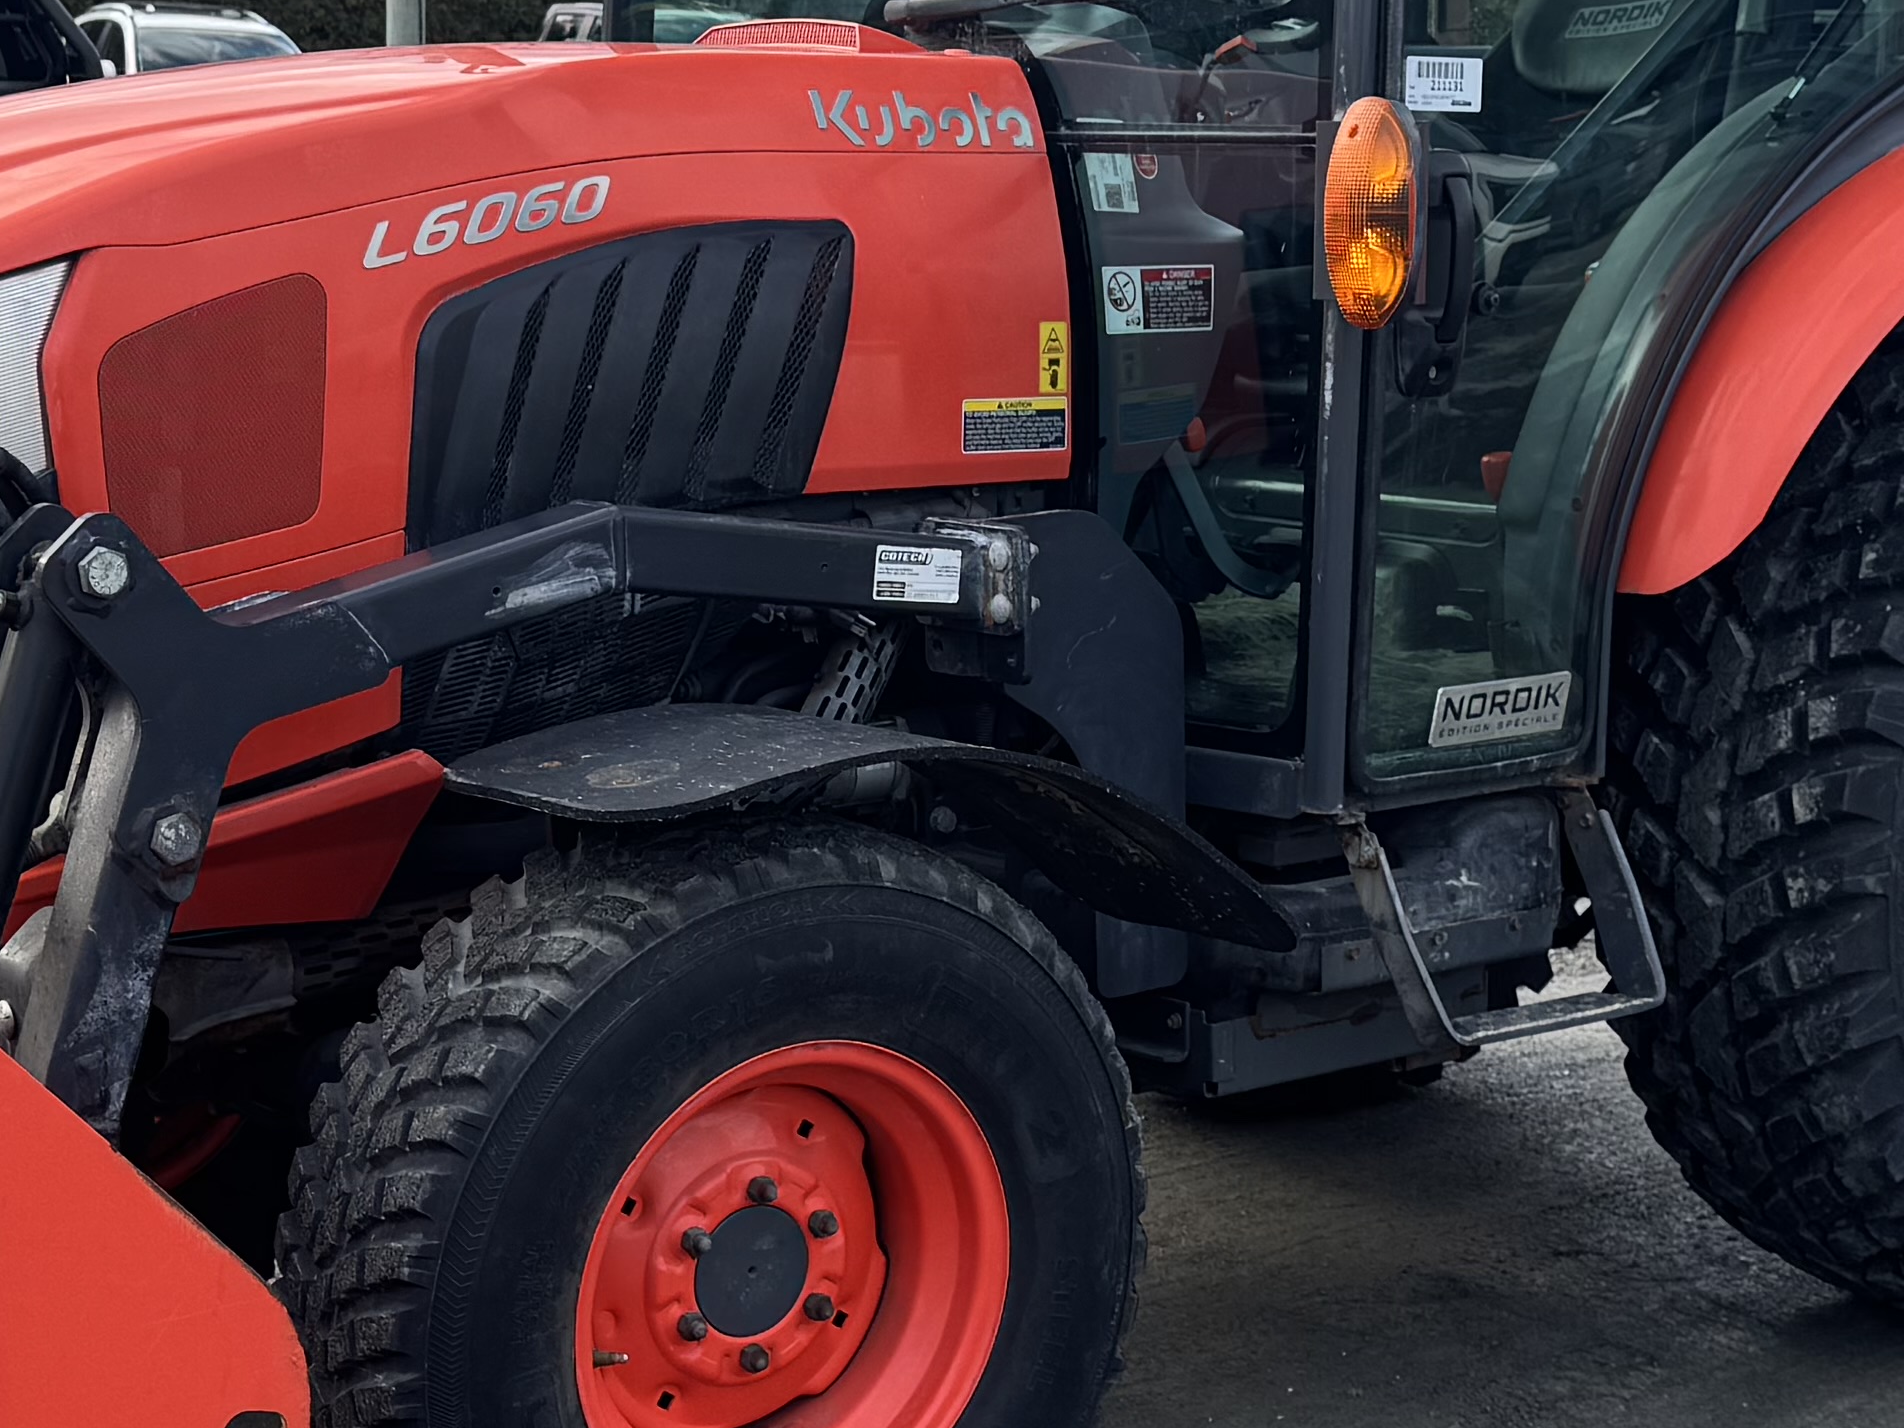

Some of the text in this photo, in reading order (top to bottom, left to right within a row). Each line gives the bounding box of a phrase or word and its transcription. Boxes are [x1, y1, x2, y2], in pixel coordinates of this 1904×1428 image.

[1573, 0, 1672, 26] NORDIK
[1430, 80, 1464, 92] 211131
[807, 89, 1034, 148] Kubota
[362, 174, 611, 270] L6060
[1442, 681, 1565, 723] NORDIK
